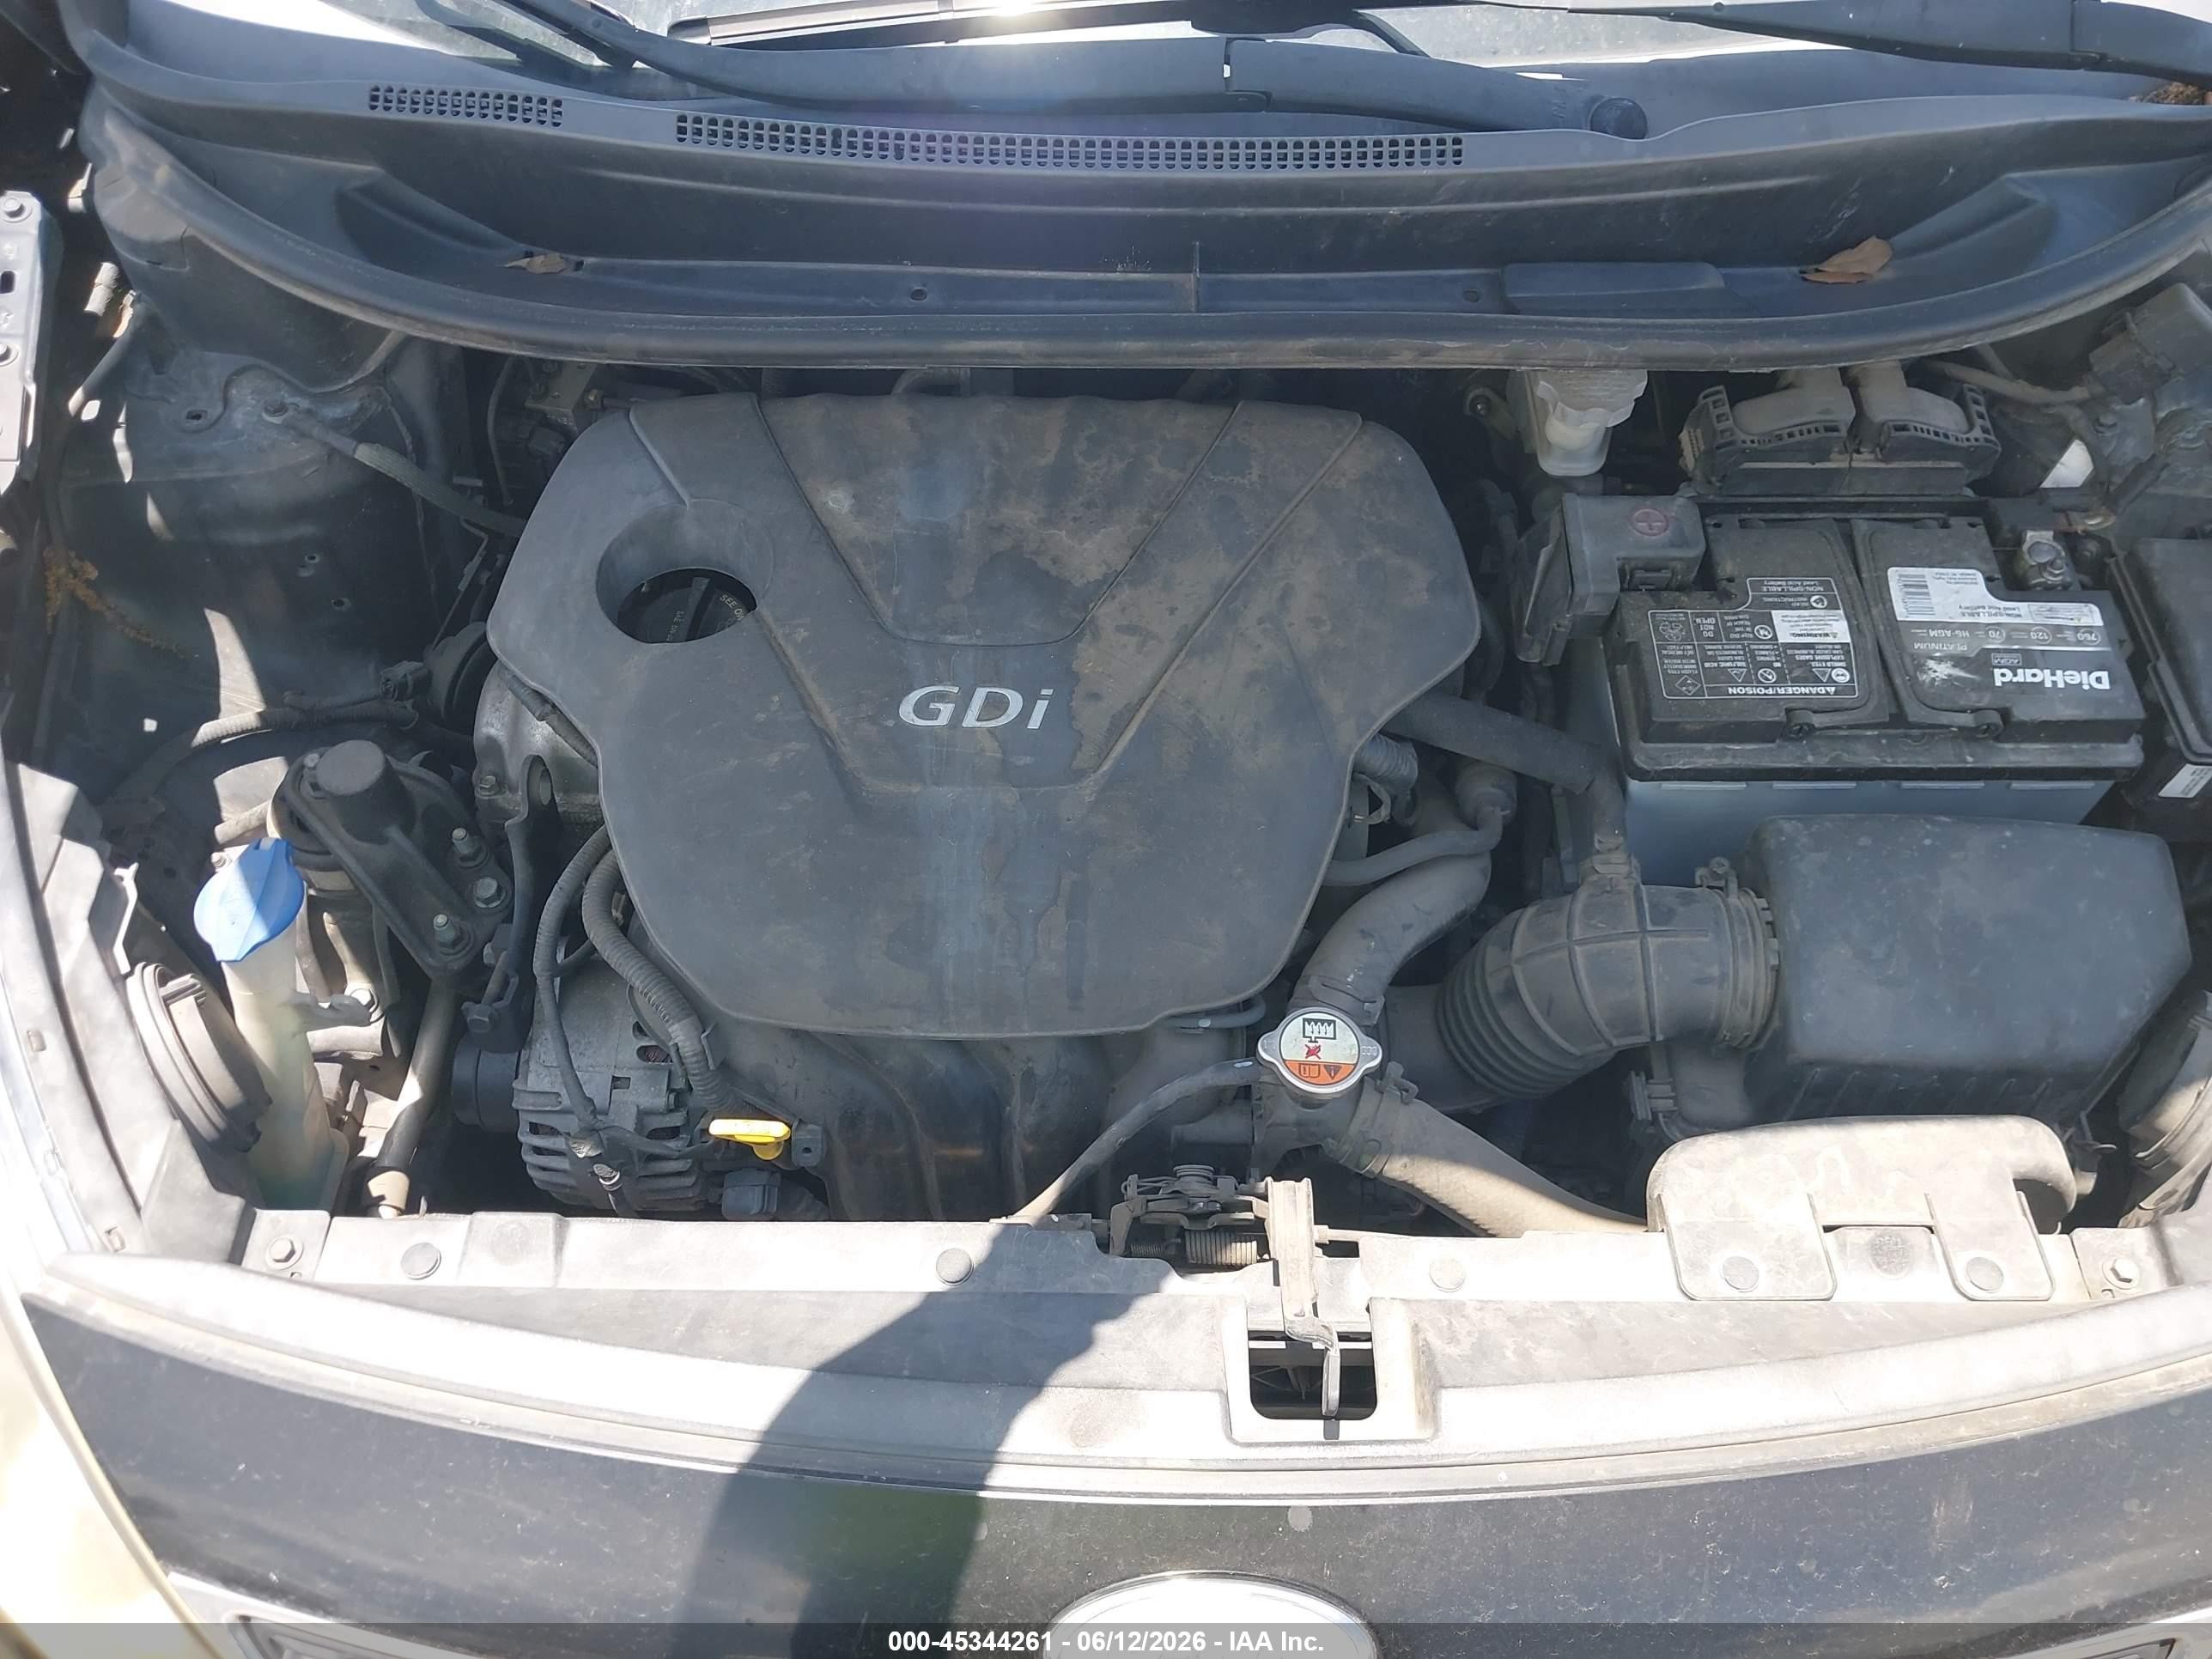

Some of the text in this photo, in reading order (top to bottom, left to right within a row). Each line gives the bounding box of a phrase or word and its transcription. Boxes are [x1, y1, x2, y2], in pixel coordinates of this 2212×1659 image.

[720, 594, 738, 608] SEE
[1914, 642, 1967, 651] PLATINUM
[1993, 668, 2111, 690] DieHard
[898, 685, 1054, 730] GDi
